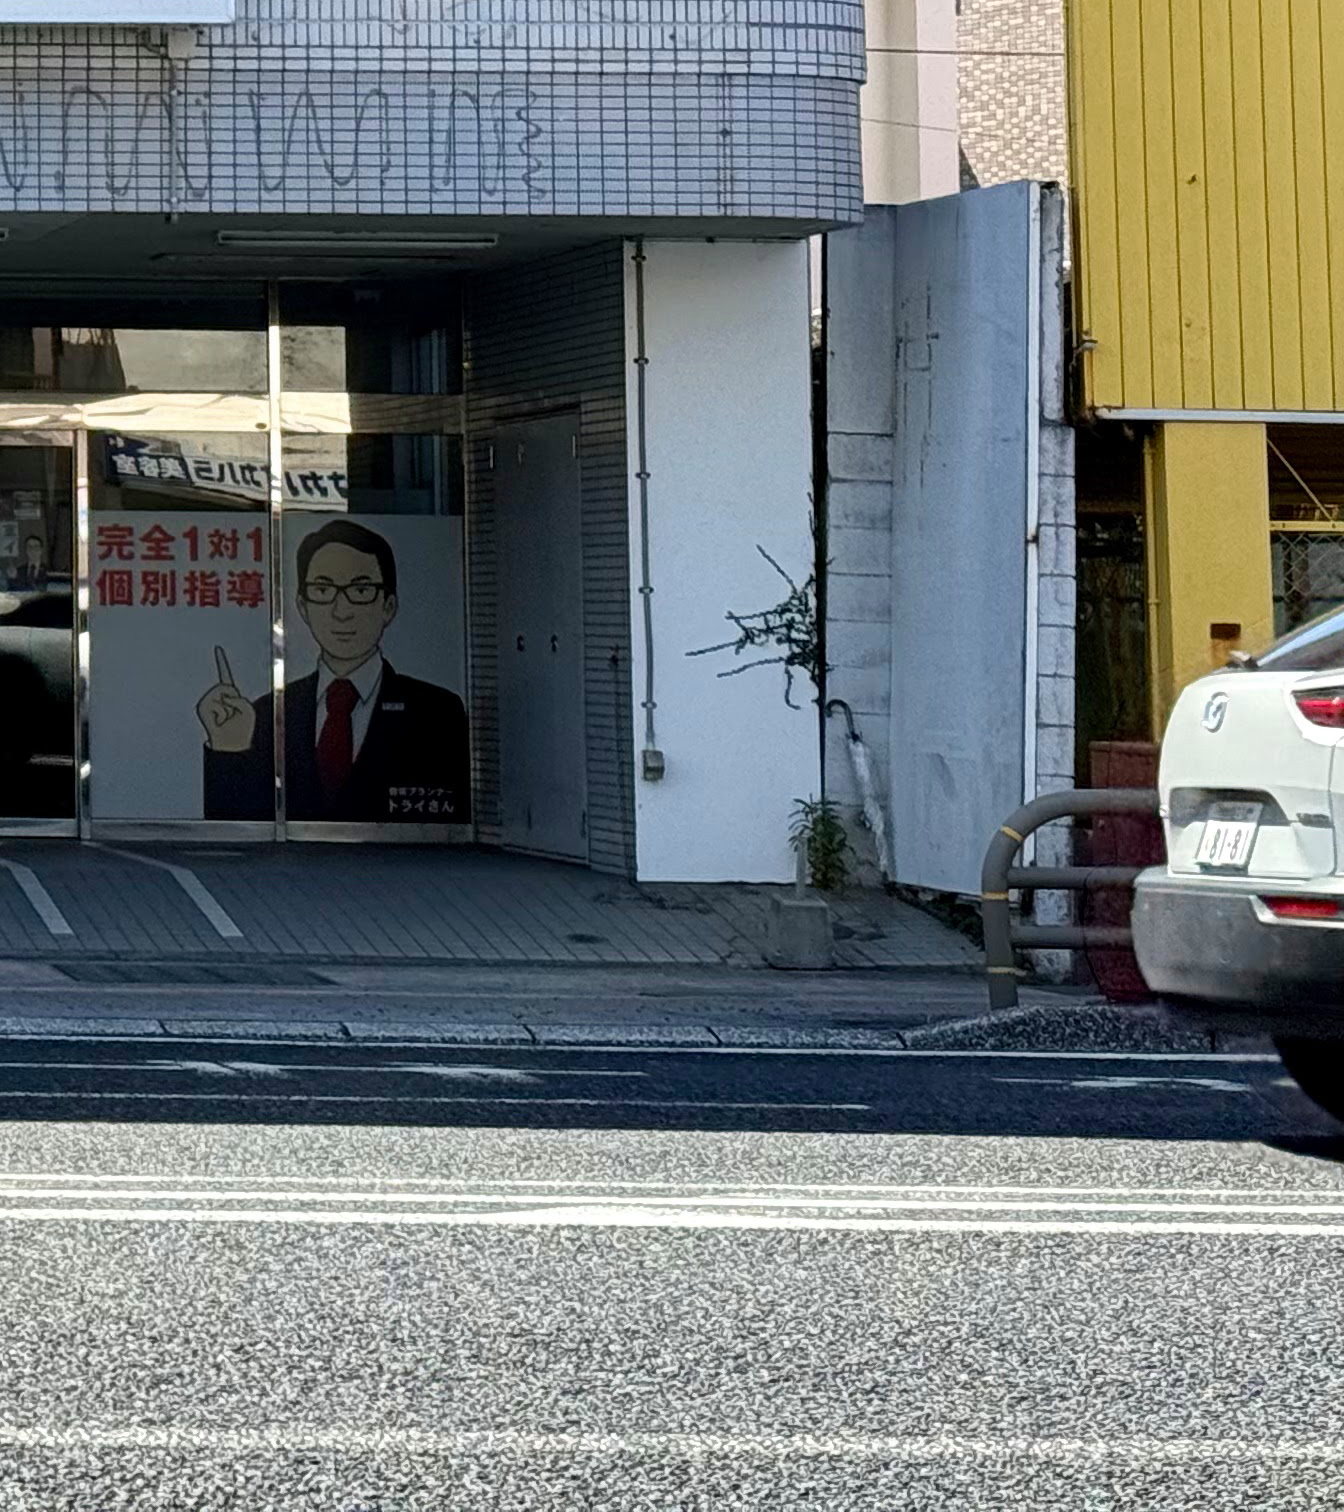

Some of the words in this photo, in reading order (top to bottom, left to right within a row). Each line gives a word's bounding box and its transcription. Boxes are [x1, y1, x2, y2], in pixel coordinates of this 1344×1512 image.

[97, 523, 262, 562] 完全1対1
[96, 569, 265, 608] 個別指導
